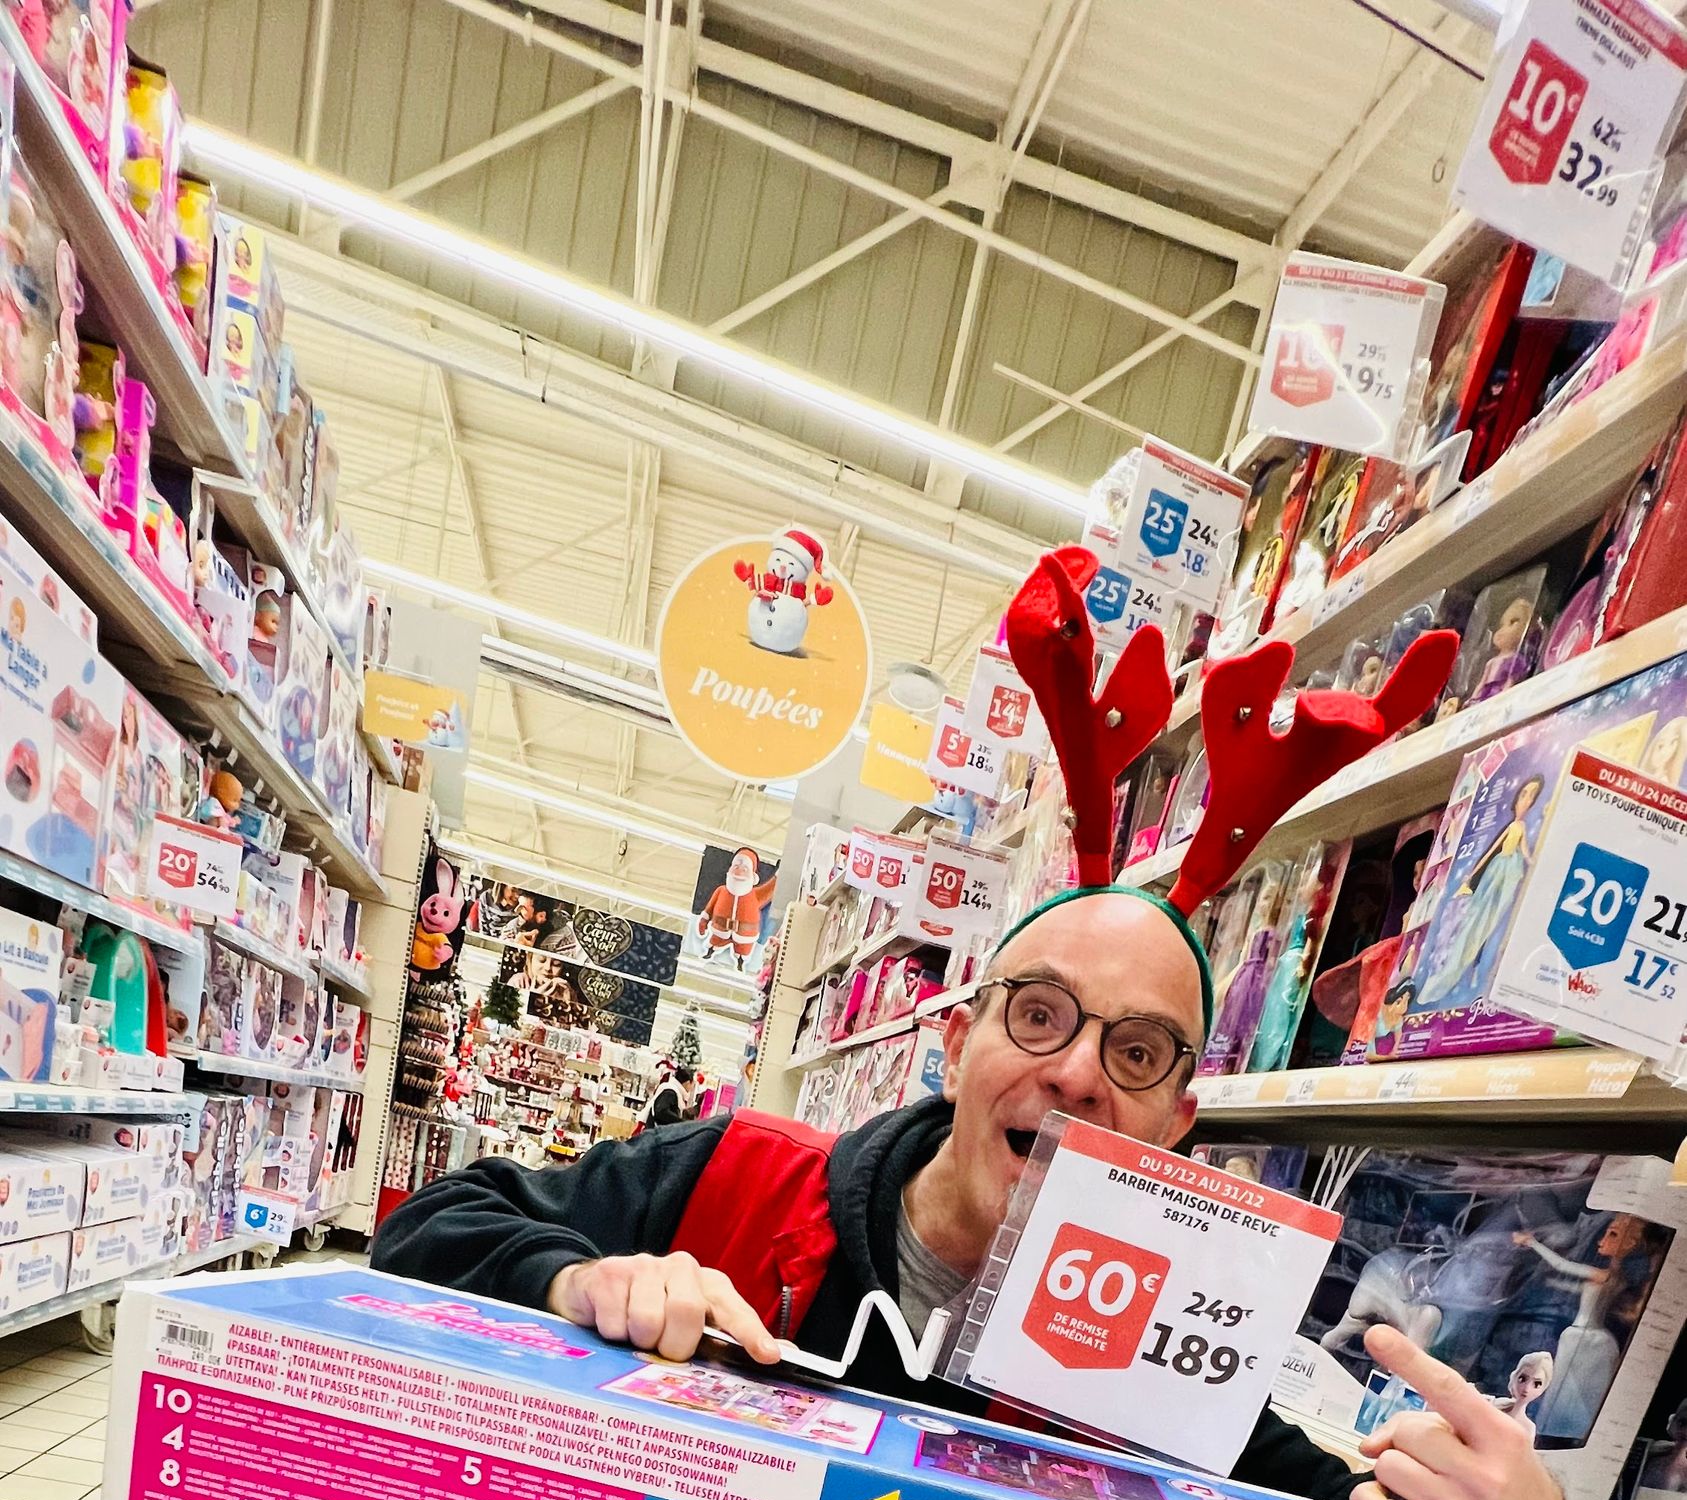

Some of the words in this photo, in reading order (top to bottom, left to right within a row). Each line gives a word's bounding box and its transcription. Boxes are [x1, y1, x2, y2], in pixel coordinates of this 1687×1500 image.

[689, 667, 824, 729] Poupées
[1478, 787, 1489, 803] 2
[1599, 769, 1616, 782] DU
[1631, 781, 1645, 795] AU
[1572, 780, 1585, 792] GP
[1587, 785, 1610, 804] TOYS
[1612, 796, 1644, 818] POUPEE
[1646, 810, 1680, 832] UNIQUE
[1457, 842, 1475, 860] 22
[1560, 868, 1638, 926] 20%
[1138, 1155, 1162, 1173] DU
[1163, 1162, 1197, 1186] 9/12
[1197, 1178, 1221, 1193] AU
[1224, 1183, 1265, 1209] 31/12
[1108, 1168, 1161, 1195] BARBIE
[1161, 1186, 1220, 1219] MAISON
[1220, 1207, 1241, 1224] DE
[1241, 1215, 1281, 1238] REVE
[1163, 1208, 1210, 1233] 587176
[1046, 1248, 1162, 1317] 60€
[1182, 1291, 1255, 1328] 249€
[1046, 1321, 1108, 1352] IMMÉDIATE
[1053, 1311, 1070, 1324] DE
[1069, 1316, 1110, 1340] REMISE
[1141, 1321, 1259, 1385] 189€
[1282, 1355, 1308, 1373] OZEN
[152, 1383, 193, 1414] 10
[281, 1336, 349, 1361] ENTIÈREMENT
[351, 1353, 442, 1386] PERSONNALISABLE
[457, 1379, 519, 1405] INDIVIDUELL
[522, 1395, 598, 1423] VERÄNDERBAR!
[607, 1416, 693, 1448] COMPLETAMENTE
[696, 1438, 796, 1472] PERSONALIZZABILE!
[161, 1424, 186, 1451] 4
[226, 1356, 278, 1376] UTETTAVA!
[287, 1369, 307, 1383] KAN
[310, 1374, 359, 1396] TILPASSES
[362, 1387, 389, 1403] HELT!
[397, 1397, 462, 1422] FULLSTENDIG
[466, 1413, 528, 1438] TILPASSBAR!
[644, 1458, 728, 1488] DOSTOSOWANIA!
[358, 1370, 445, 1402] PERSONALIZABLE!
[454, 1394, 517, 1420] TOTALMENTE
[617, 1435, 641, 1449] HELT
[643, 1442, 738, 1475] ANPASSNINGSBAR!
[410, 1416, 435, 1431] PLNE
[158, 1458, 182, 1487] 8
[459, 1455, 483, 1485] 5
